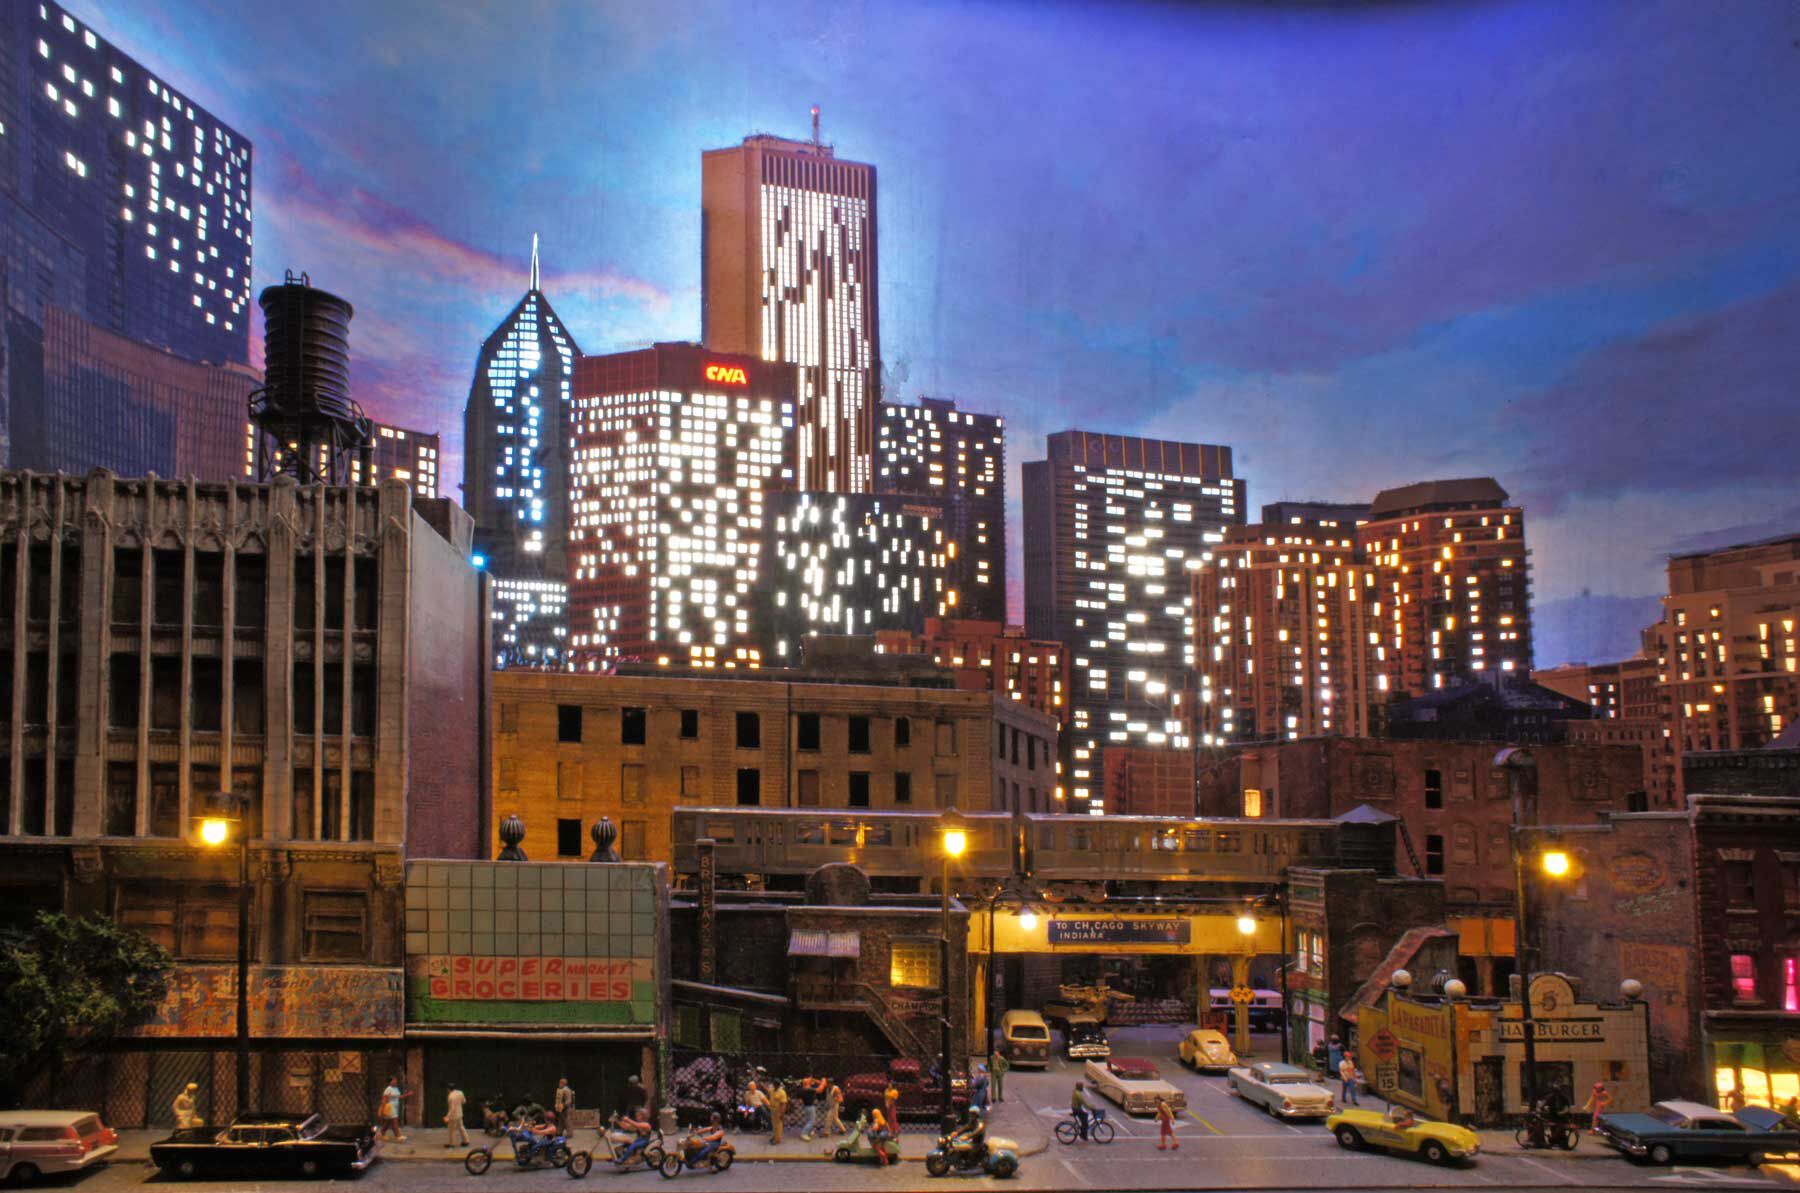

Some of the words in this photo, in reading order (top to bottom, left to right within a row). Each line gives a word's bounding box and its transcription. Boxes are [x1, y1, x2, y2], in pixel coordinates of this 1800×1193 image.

[706, 365, 747, 385] CNA
[1056, 922, 1068, 930] TO
[1133, 922, 1181, 931] SKYWAY
[1059, 932, 1105, 940] INDIANA
[454, 957, 563, 976] SUPER
[566, 962, 631, 976] MARKET
[431, 978, 629, 998] GROCERIES
[1500, 1024, 1601, 1036] HABURGER
[1382, 1078, 1394, 1089] 15
